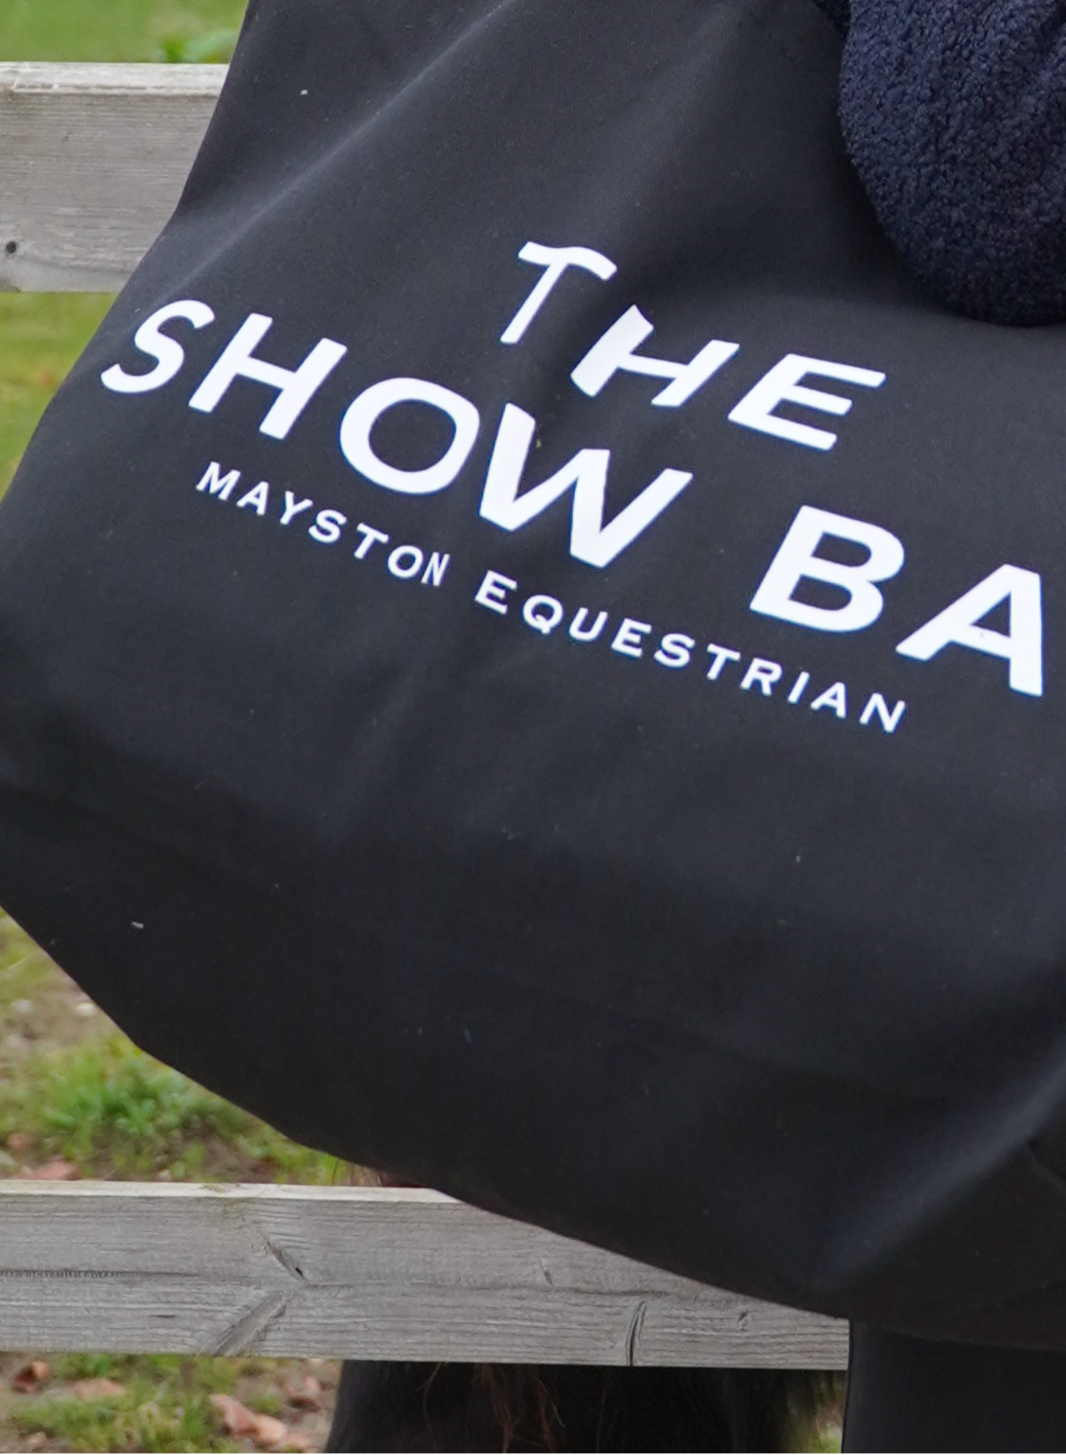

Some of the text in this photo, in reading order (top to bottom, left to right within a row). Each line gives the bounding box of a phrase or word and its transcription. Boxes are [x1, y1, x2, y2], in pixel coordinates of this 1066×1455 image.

[101, 300, 692, 567] SHOW
[501, 242, 885, 449] THE
[197, 462, 904, 731] MAYSTON EQUESTRIAN
